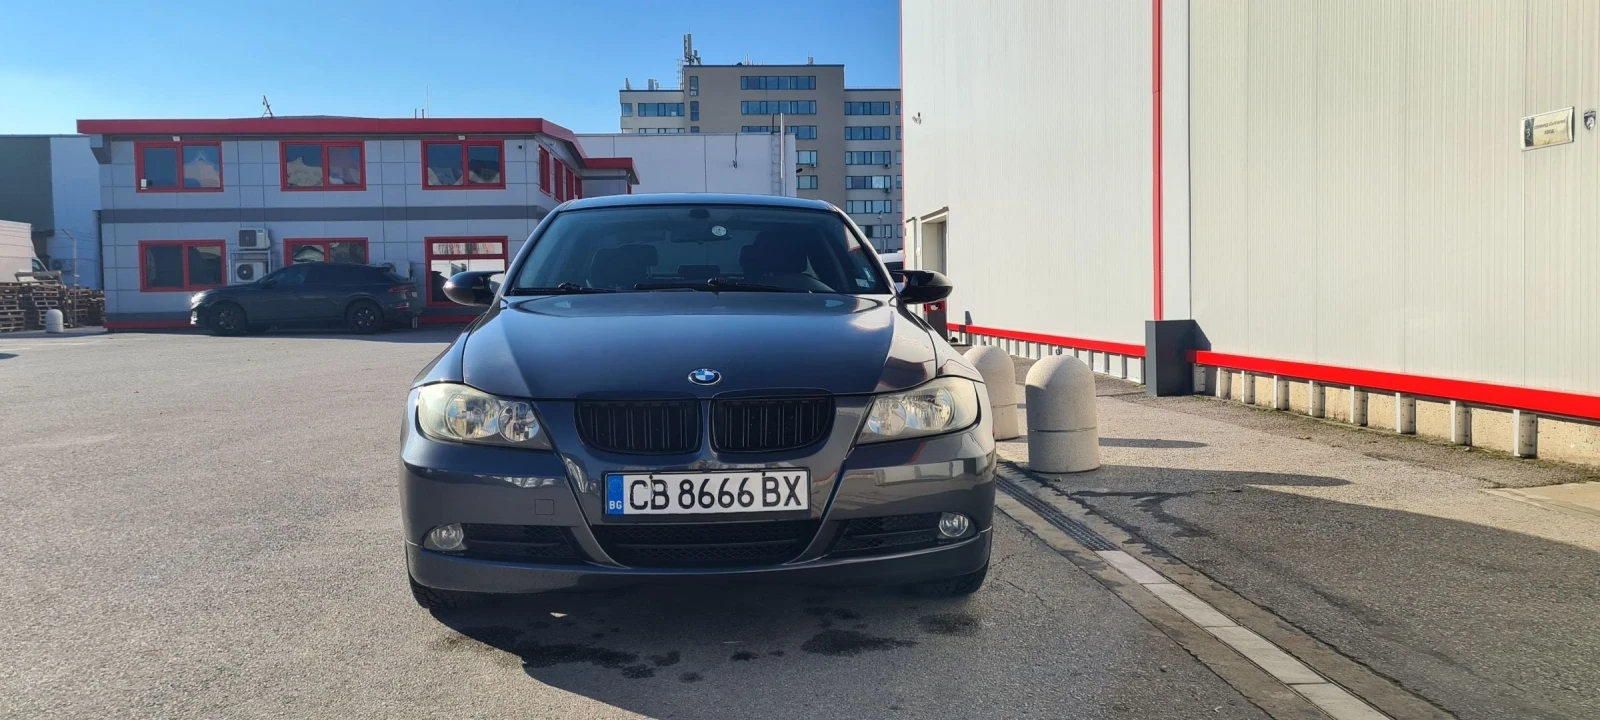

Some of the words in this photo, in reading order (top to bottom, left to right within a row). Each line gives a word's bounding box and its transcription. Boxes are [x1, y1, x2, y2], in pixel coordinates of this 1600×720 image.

[629, 479, 670, 510] CB
[677, 477, 755, 509] 8666
[761, 475, 802, 507] BX
[609, 500, 622, 510] BG
